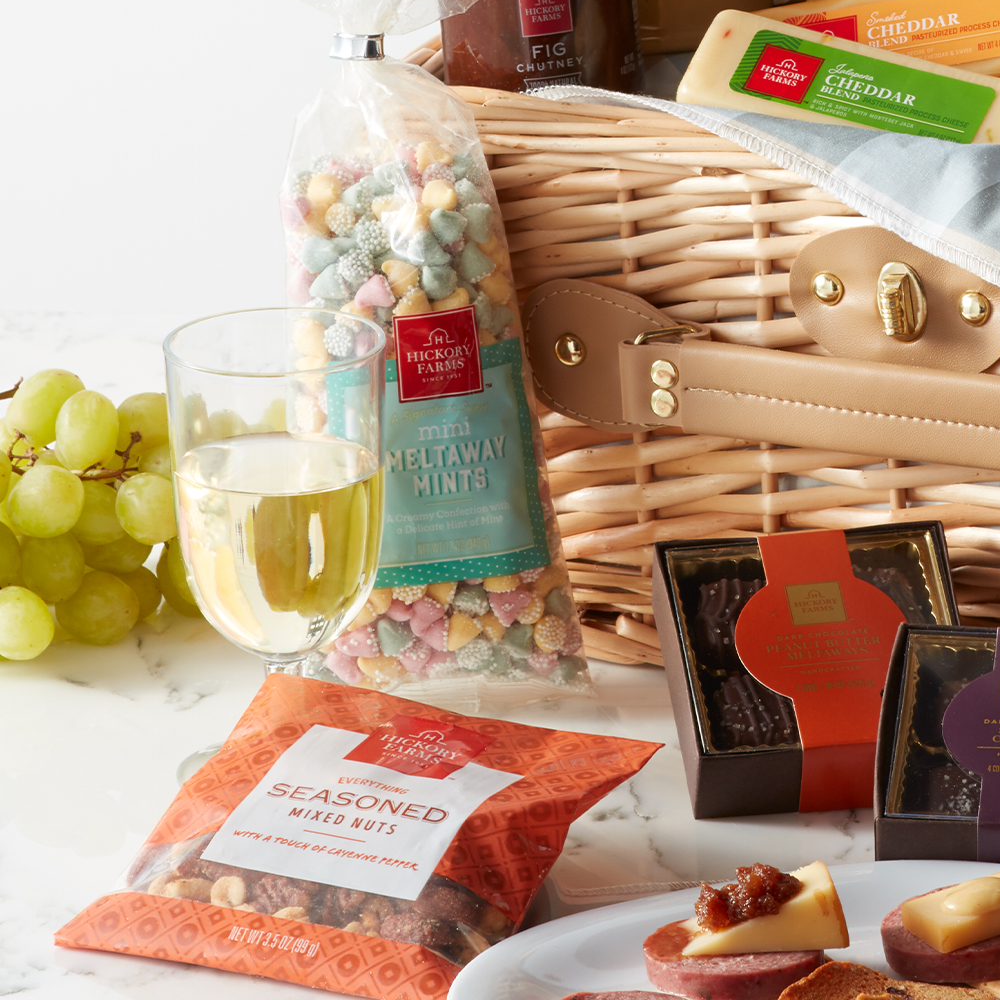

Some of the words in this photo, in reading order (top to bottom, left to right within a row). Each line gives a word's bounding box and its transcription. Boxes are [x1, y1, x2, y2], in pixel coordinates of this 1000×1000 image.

[525, 4, 566, 16] HICKORY
[532, 12, 562, 23] FARMS
[866, 10, 906, 27] Smoked
[866, 12, 960, 40] CHEDDAR
[868, 35, 908, 48] BLEND
[911, 28, 958, 42] PASTEURIZED
[959, 22, 992, 34] PROCESS
[532, 42, 567, 59] FIG
[516, 56, 584, 73] CHUTNEY
[760, 64, 808, 82] HICKORY
[763, 73, 798, 87] FARMS
[825, 74, 916, 106] CHEDDAR
[812, 98, 826, 108] RICH
[834, 104, 852, 113] SPICY
[852, 109, 868, 117] WITH
[868, 114, 898, 125] MONTEREY
[820, 85, 860, 101] BLEND
[862, 96, 909, 114] PASTEURIZED
[908, 108, 941, 122] PROCESS
[942, 117, 970, 128] CHEESE
[406, 344, 471, 362] HICKORY
[417, 358, 465, 375] FARMS
[418, 417, 471, 441] mini
[386, 434, 507, 473] MELTAWAY
[413, 467, 490, 498] MINTS
[386, 514, 394, 524] A
[396, 512, 435, 524] Creamy
[436, 505, 488, 519] Confection
[490, 501, 510, 511] with
[404, 522, 444, 534] Delicate
[446, 520, 468, 530] Hint
[470, 517, 480, 527] of
[481, 514, 504, 525] Mint
[794, 598, 838, 608] HICKORY
[801, 605, 834, 614] FARMS
[777, 633, 804, 642] DARK
[808, 628, 870, 638] CHOCOLATE
[766, 642, 822, 654] PEANUT
[826, 636, 882, 648] BUTTER
[787, 646, 868, 661] MELTAWAYS
[800, 665, 862, 674] HANDCRAFTED
[380, 732, 462, 761] HICKORY
[382, 742, 443, 766] FARMS
[338, 776, 410, 795] EVERYTHING
[266, 782, 450, 825] SEASONED
[288, 807, 346, 826] MIXED
[350, 818, 398, 836] NUTS
[233, 830, 263, 841] WITH
[274, 837, 310, 850] TOUCH
[310, 844, 328, 854] OF
[327, 848, 379, 864] CAYENNE
[378, 858, 420, 872] PEPPER
[228, 926, 249, 942] NET
[247, 929, 265, 945] WT
[262, 932, 281, 948] 3.5
[278, 935, 295, 950] OZ
[291, 938, 310, 954] (99
[306, 942, 320, 958] g)
